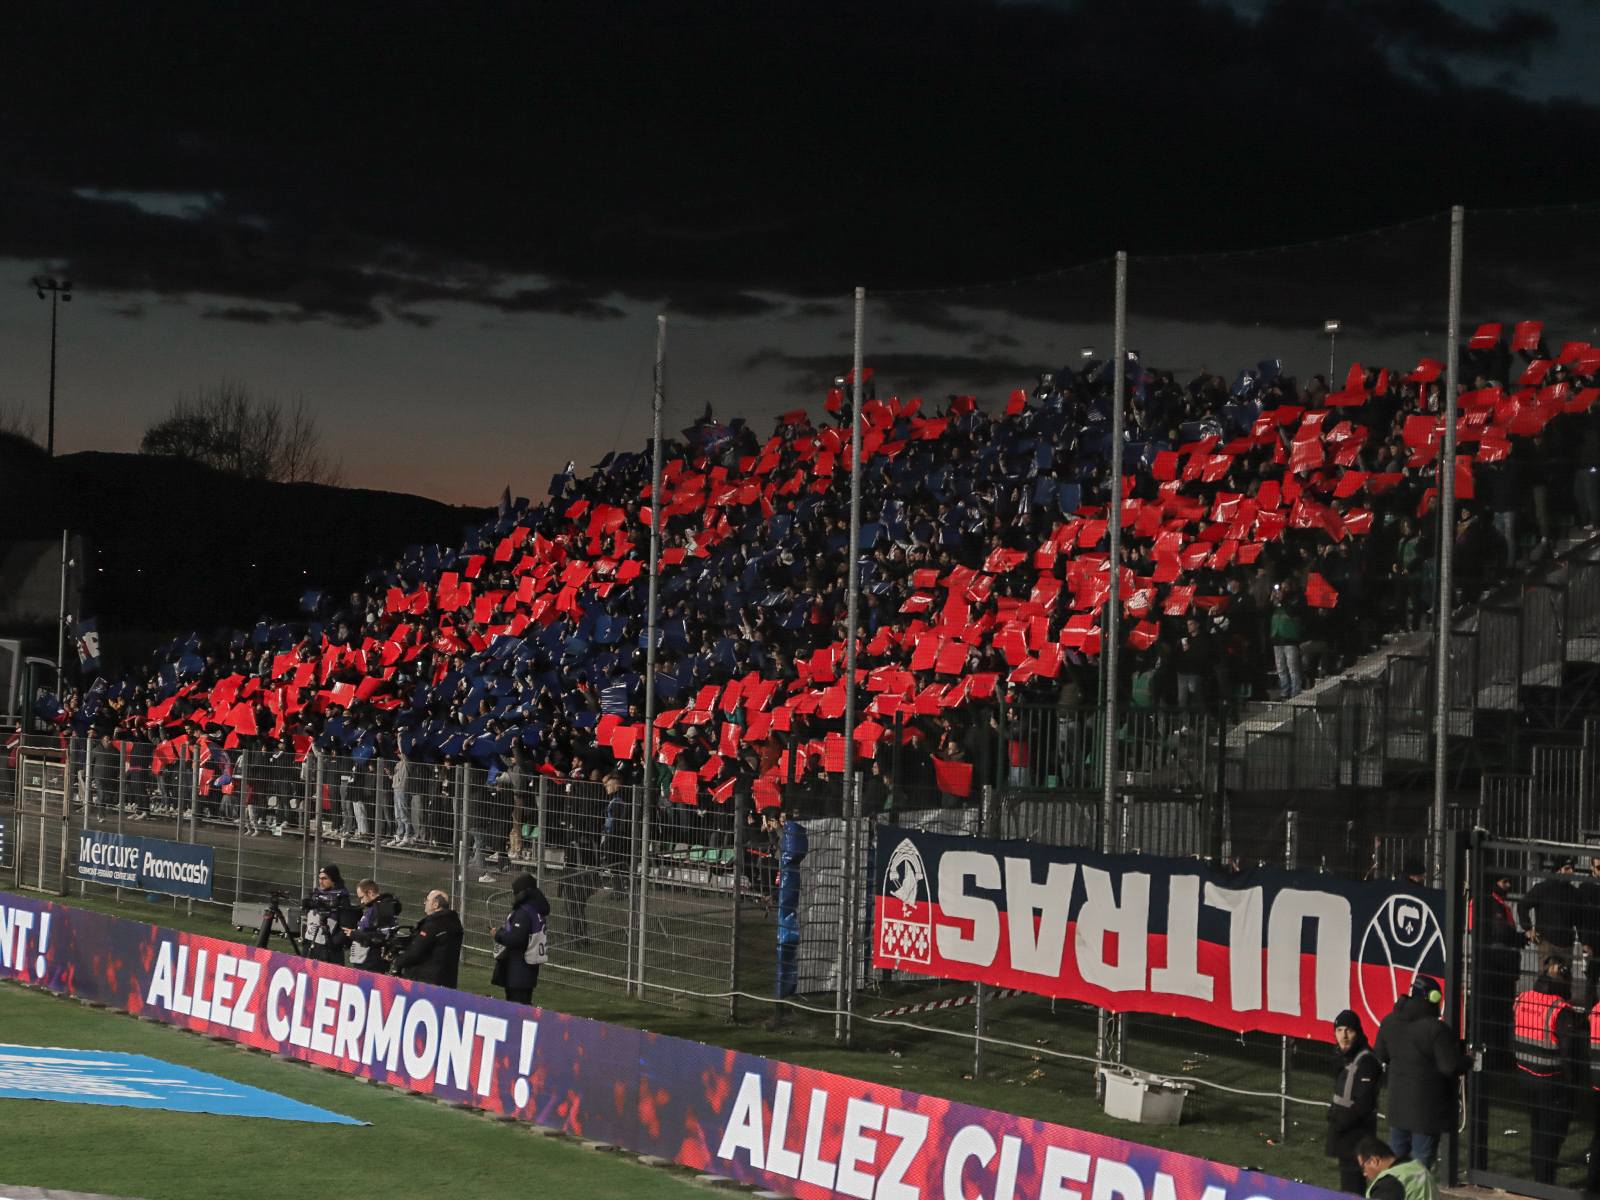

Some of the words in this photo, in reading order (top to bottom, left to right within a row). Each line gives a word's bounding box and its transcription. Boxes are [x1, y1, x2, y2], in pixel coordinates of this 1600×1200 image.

[79, 837, 139, 869] Mercure
[143, 851, 208, 885] Promocash
[936, 850, 1352, 1022] ULTRAS
[146, 940, 262, 1033] ALLEZ
[266, 966, 509, 1097] CLERMONT
[716, 1071, 930, 1200] ALLEZ
